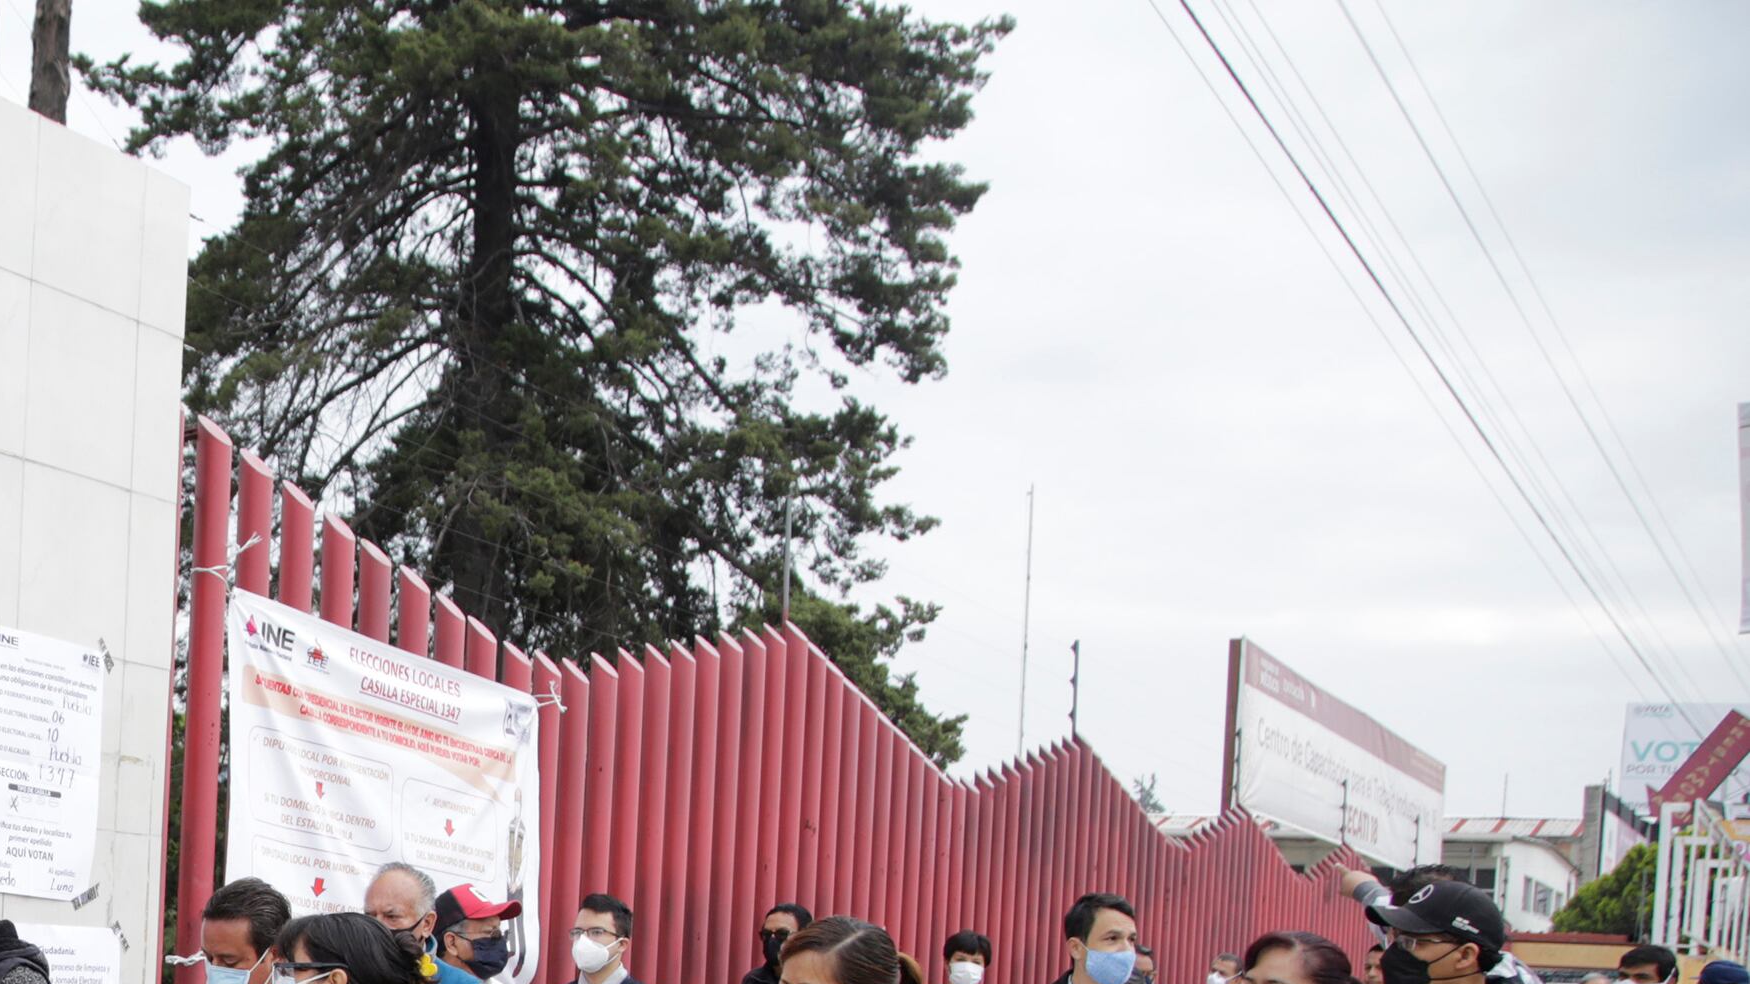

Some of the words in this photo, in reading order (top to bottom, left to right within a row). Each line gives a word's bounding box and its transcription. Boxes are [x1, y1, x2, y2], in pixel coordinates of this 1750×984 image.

[262, 621, 296, 652] INE
[89, 655, 100, 667] IEE
[350, 647, 410, 682] ELECCIONES
[412, 668, 461, 697] LOCALES
[361, 676, 398, 701] CASILLA
[400, 689, 439, 714] ESPECIAL
[440, 703, 461, 720] 1347
[52, 710, 65, 725] 06
[47, 728, 59, 743] 10
[1258, 716, 1289, 759] Centro
[1291, 732, 1303, 766] de
[1631, 740, 1701, 763] VOT
[322, 754, 338, 767] POR
[1626, 764, 1655, 776] POR
[345, 814, 376, 829] DENTRO
[6, 846, 27, 858] AQUÍ
[29, 850, 54, 861] VOTAN
[290, 854, 311, 868] LOCAL
[313, 857, 331, 871] POR
[313, 900, 319, 911] SE
[54, 976, 78, 984] Jornada
[79, 976, 103, 984] Electoral
